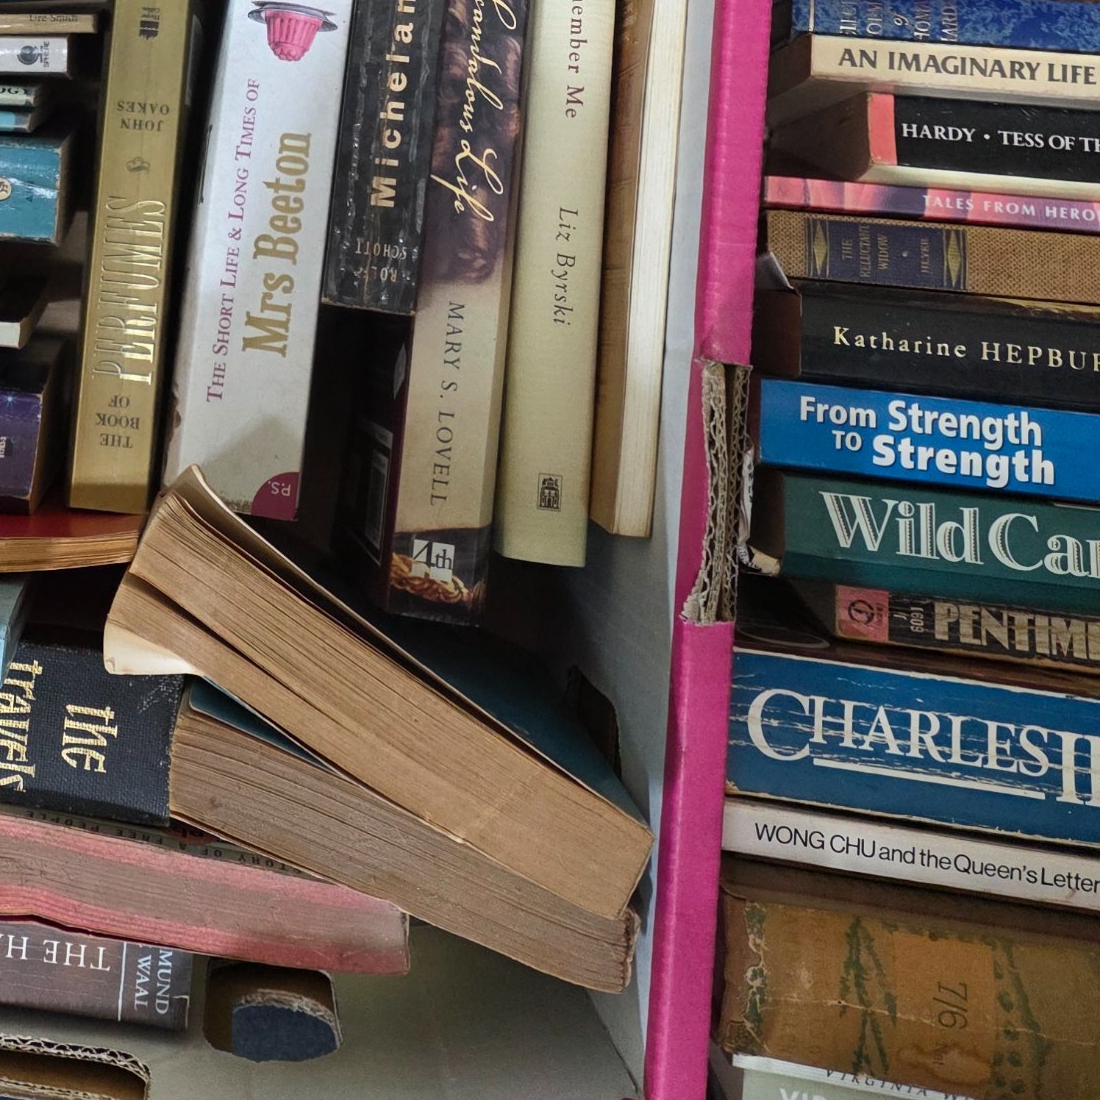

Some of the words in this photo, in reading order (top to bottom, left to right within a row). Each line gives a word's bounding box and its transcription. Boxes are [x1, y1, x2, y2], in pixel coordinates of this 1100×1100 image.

[838, 48, 878, 69] AN
[887, 51, 1042, 81] IMAGINARY
[1047, 61, 1098, 85] LIFE
[117, 100, 171, 117] OAKES
[247, 78, 259, 102] OF
[565, 84, 585, 118] Me
[120, 118, 165, 132] JOHN
[234, 108, 256, 162] TIMES
[901, 123, 977, 143] HARDY
[998, 130, 1045, 148] TESS
[1048, 133, 1076, 152] OF
[227, 167, 250, 221] LONG
[253, 132, 312, 265] Beeton
[922, 195, 974, 211] TALES
[983, 200, 1036, 217] FROM
[227, 227, 242, 241] &
[558, 206, 579, 242] Liz
[220, 246, 241, 291] LIFE
[877, 234, 889, 271] WIDOW
[552, 252, 577, 326] Byrski
[211, 293, 235, 356] SHORT
[242, 273, 295, 358] Mrs
[443, 300, 465, 370] MARY
[833, 326, 967, 359] Katharine
[206, 360, 227, 402] THE
[439, 379, 458, 399] S.
[95, 413, 141, 430] BOOK
[107, 396, 131, 409] OF
[799, 395, 877, 429] From
[887, 400, 1043, 451] Strength
[100, 434, 134, 449] THE
[429, 411, 455, 507] LOVELL
[832, 430, 862, 452] TO
[872, 434, 1056, 489] Strength
[818, 490, 985, 566] Wild
[61, 702, 120, 775] the
[748, 687, 1051, 778] CHARLES
[755, 822, 826, 850] WONG
[830, 834, 876, 859] CHU
[879, 846, 916, 865] and
[919, 849, 952, 871] the
[953, 853, 1038, 884] Queen's
[43, 939, 111, 972] THE
[134, 954, 153, 1011] WAAL
